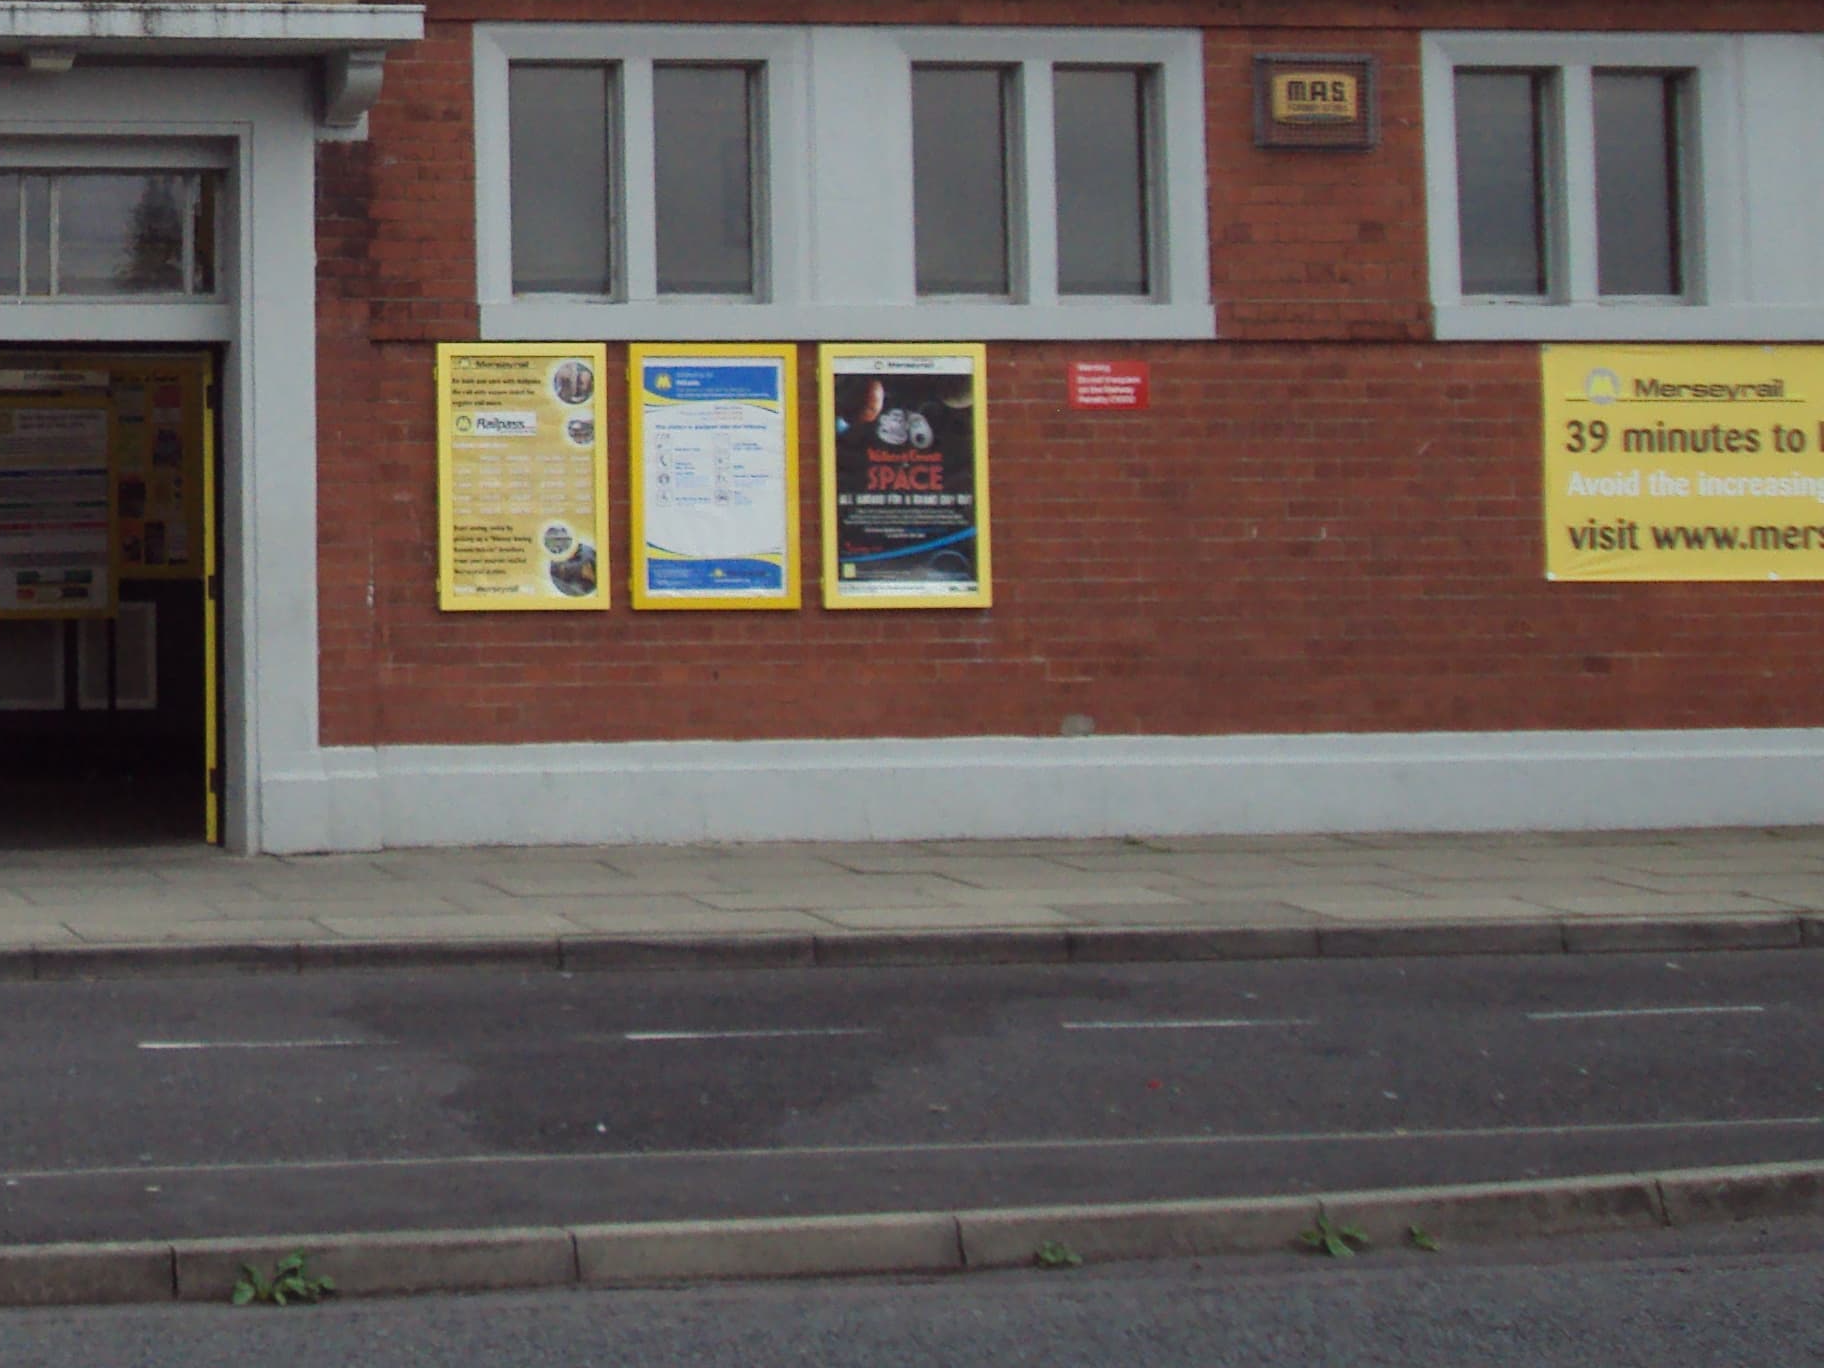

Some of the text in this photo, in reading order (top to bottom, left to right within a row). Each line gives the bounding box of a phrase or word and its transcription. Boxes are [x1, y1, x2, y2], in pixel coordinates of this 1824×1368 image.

[1634, 378, 1785, 400] Merseyrail
[477, 417, 526, 431] Railpass
[1565, 420, 1609, 453] 39
[1622, 420, 1761, 453] minutes
[1772, 423, 1806, 453] to
[867, 465, 944, 491] SPACE
[1568, 469, 1641, 497] Avoid
[1648, 470, 1691, 497] the
[1568, 518, 1641, 551] visit
